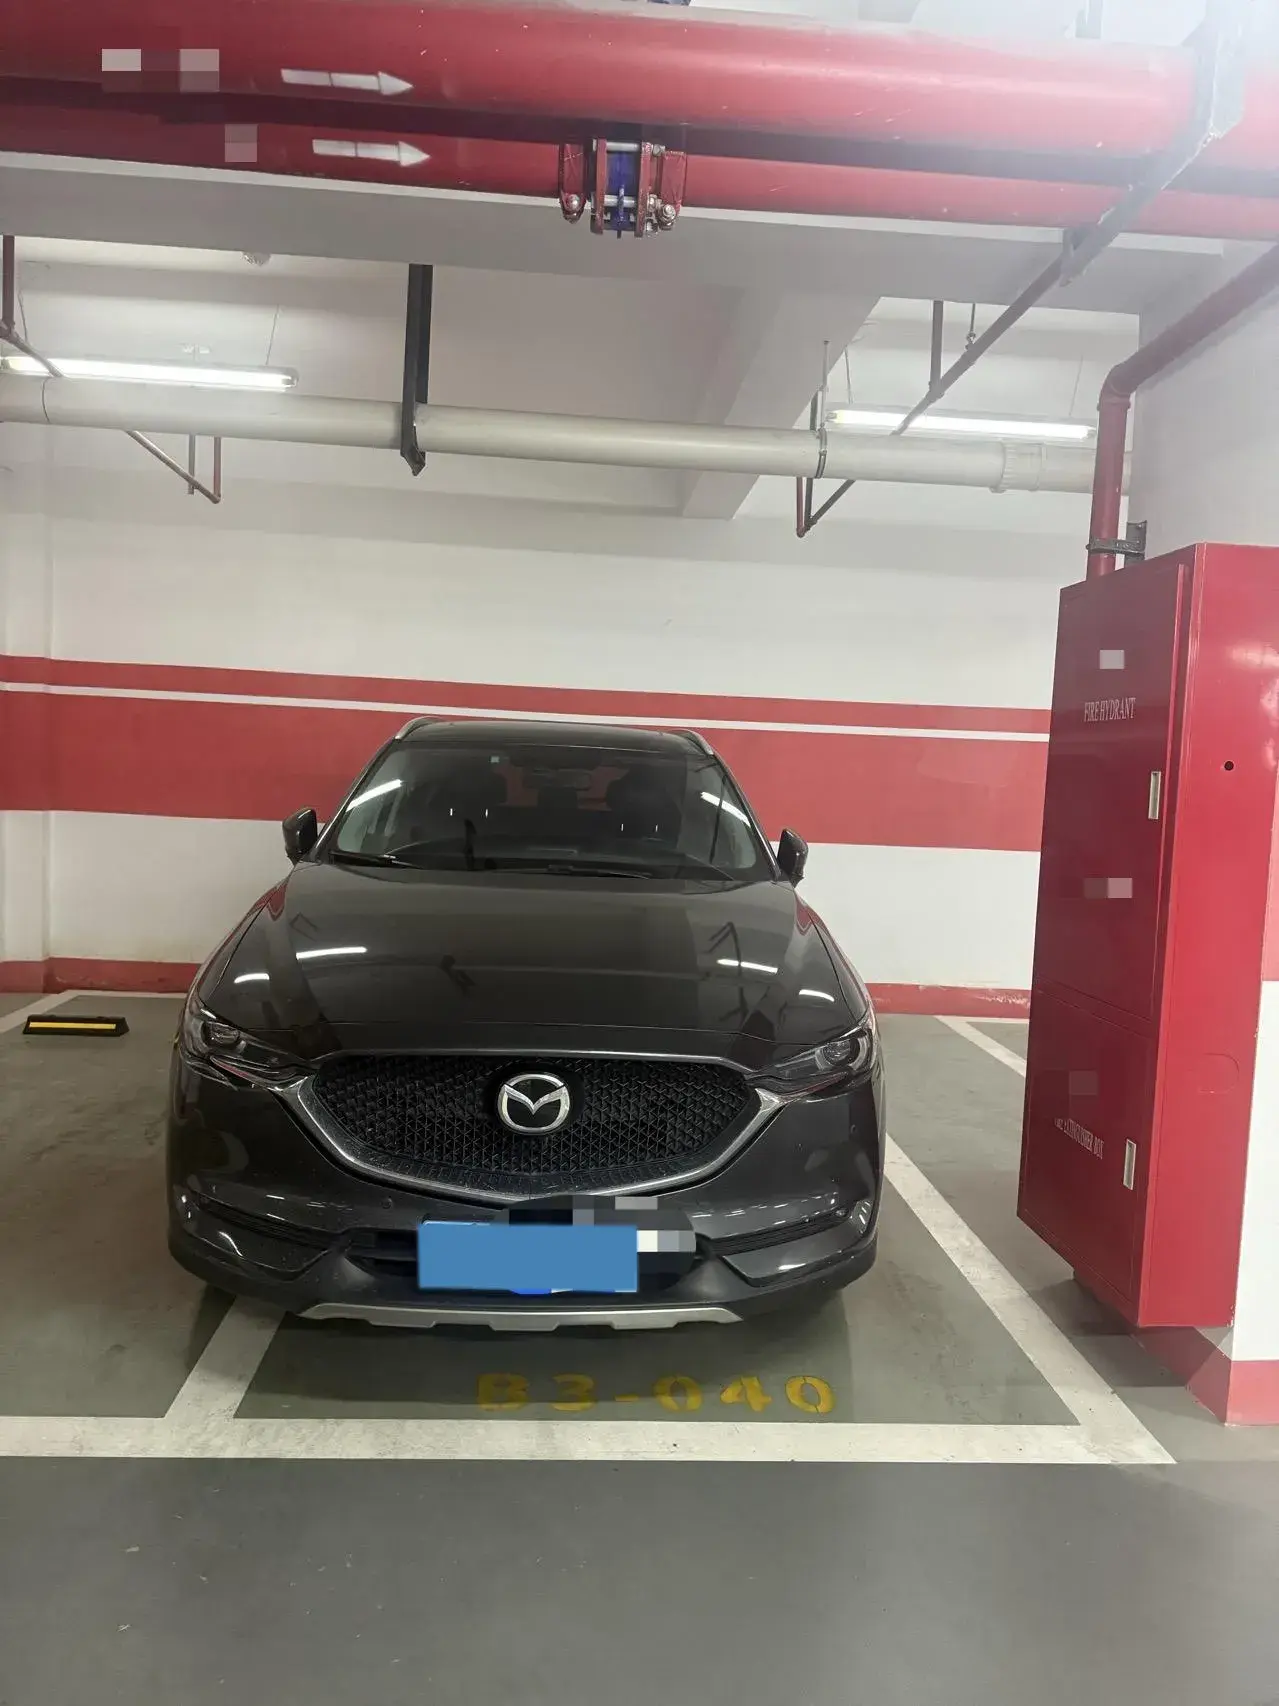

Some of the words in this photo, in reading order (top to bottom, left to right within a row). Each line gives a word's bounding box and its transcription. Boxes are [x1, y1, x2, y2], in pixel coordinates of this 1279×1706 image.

[1083, 701, 1099, 722] FIRE
[1099, 698, 1136, 721] HYDRANT
[477, 1374, 835, 1414] B3-040
